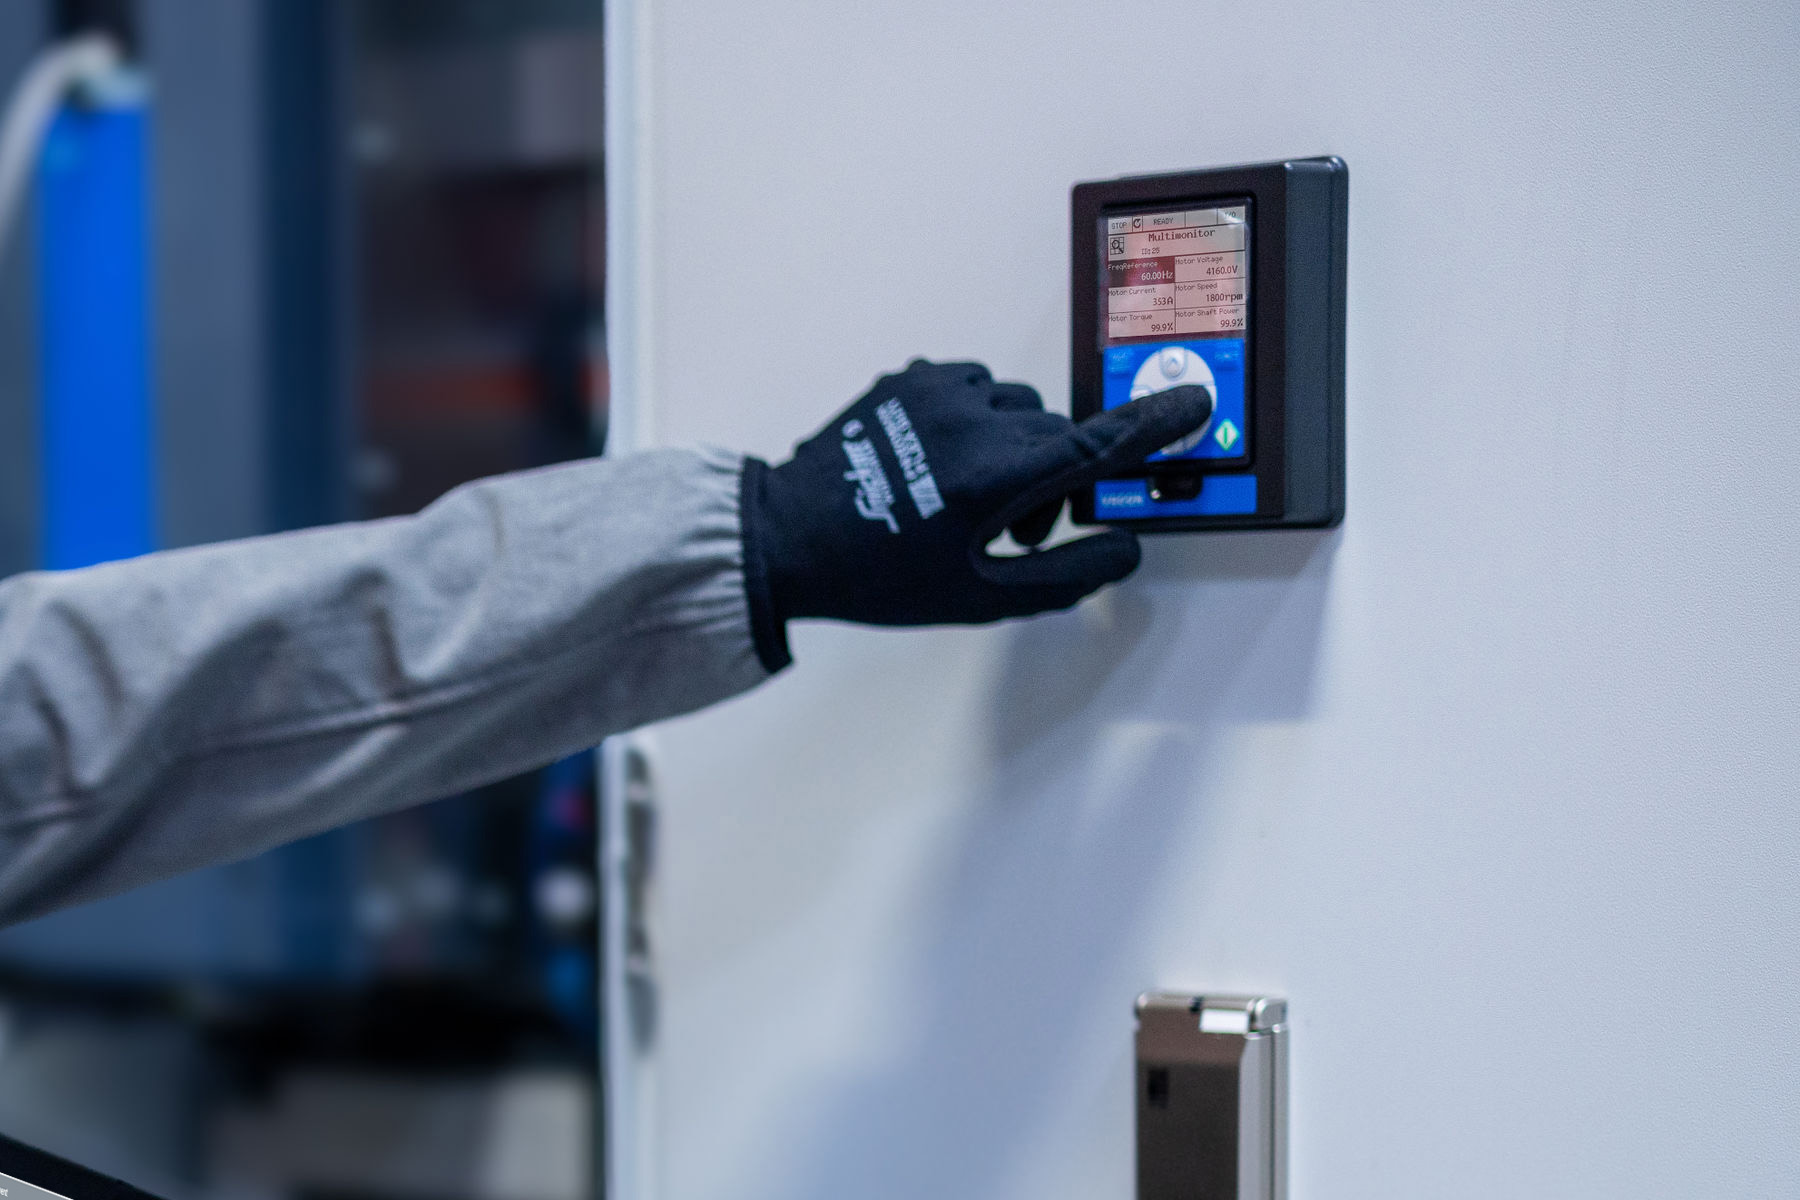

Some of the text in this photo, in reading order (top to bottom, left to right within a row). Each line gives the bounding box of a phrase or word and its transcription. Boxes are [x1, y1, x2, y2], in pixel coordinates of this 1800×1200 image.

[1148, 228, 1215, 242] Multimonitor
[1197, 256, 1223, 264] Voltage
[1108, 262, 1158, 271] FreqReference
[1206, 265, 1238, 276] 4160.0V
[1108, 287, 1156, 296] Motor Current
[1175, 282, 1218, 292] Motor Speed
[1153, 296, 1174, 306] 353A
[1206, 293, 1243, 302] 1800rpm
[1108, 314, 1152, 322] Motor Torque
[1175, 310, 1196, 318] Motor
[1197, 308, 1216, 316] Shaft
[1151, 322, 1173, 332] 99.9%
[1220, 318, 1243, 328] 99.9%
